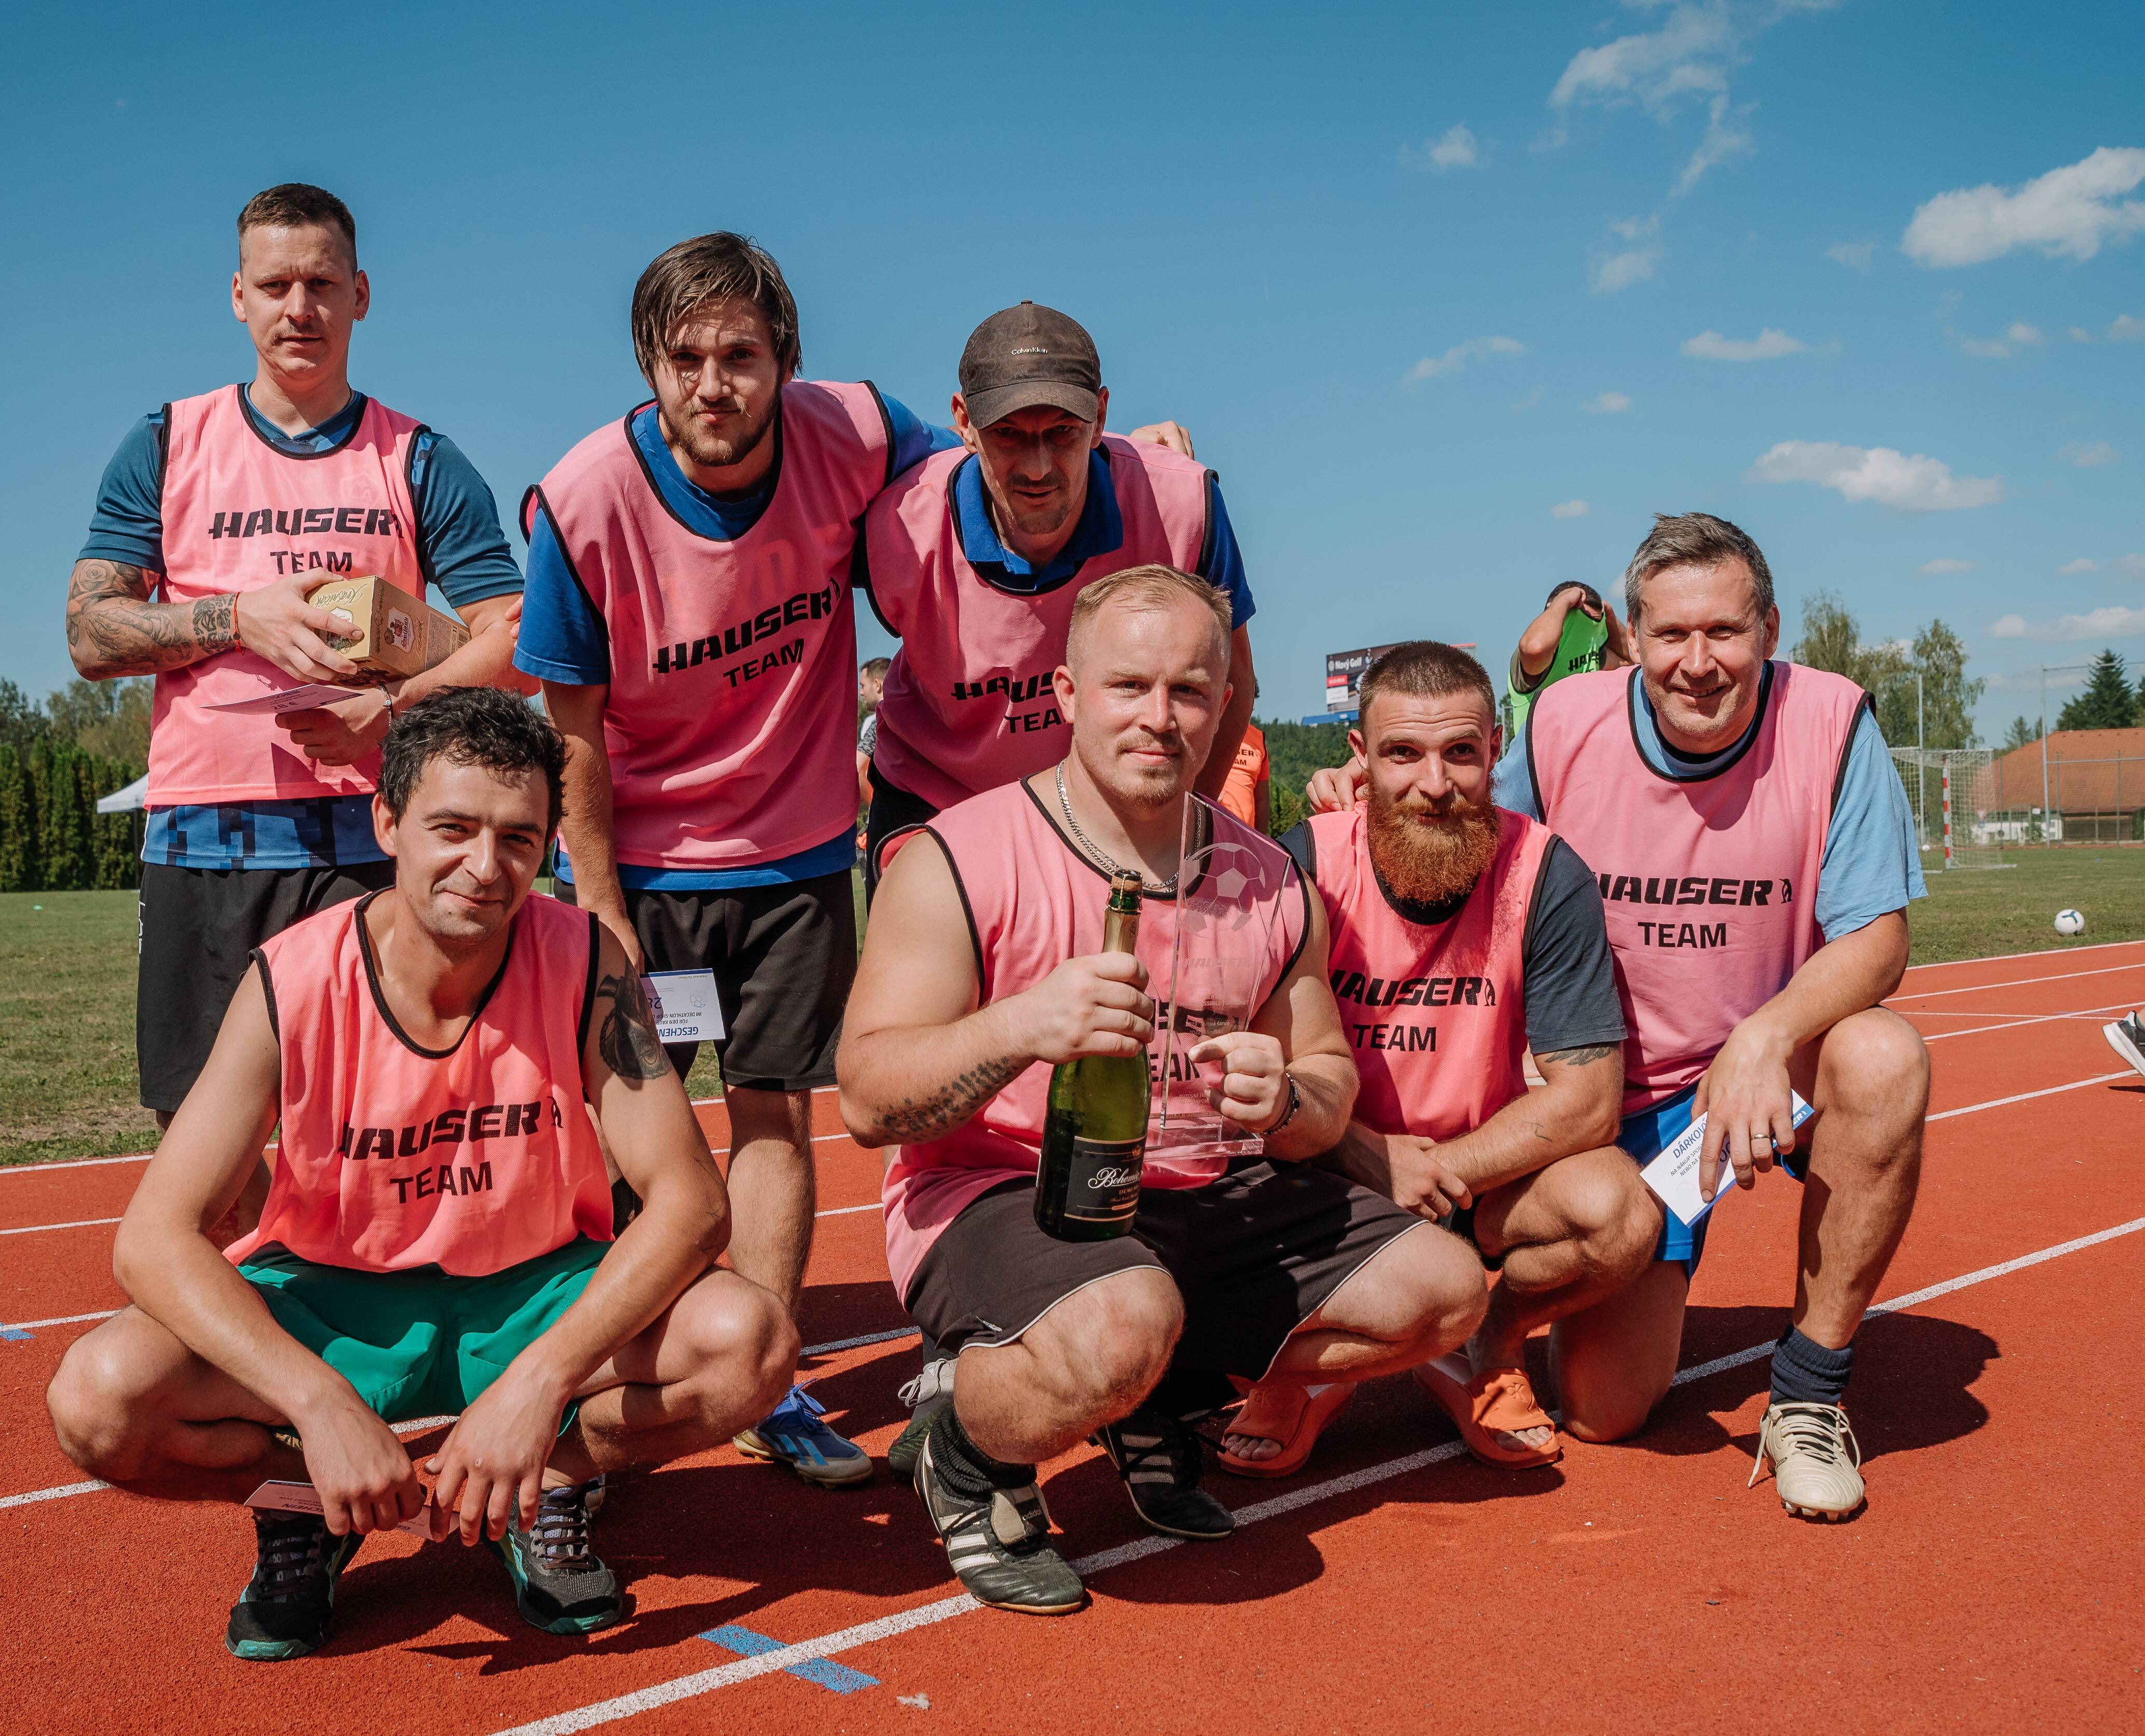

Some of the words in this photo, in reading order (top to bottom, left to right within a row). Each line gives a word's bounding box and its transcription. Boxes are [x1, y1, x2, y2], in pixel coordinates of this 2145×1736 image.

[208, 507, 394, 539] HAUSER
[270, 551, 352, 575] TEAM
[652, 587, 834, 674] HAUSER
[723, 638, 805, 688] TEAM
[1004, 707, 1066, 733] TEA
[1638, 922, 1727, 949] TEAM
[657, 1026, 699, 1037] GESCHEN
[1352, 1023, 1436, 1052] TEAM
[390, 1161, 493, 1204] TEAM
[1670, 1168, 1679, 1176] NA
[1679, 1165, 1692, 1176] NEBO
[1022, 1509, 1042, 1521] adidas
